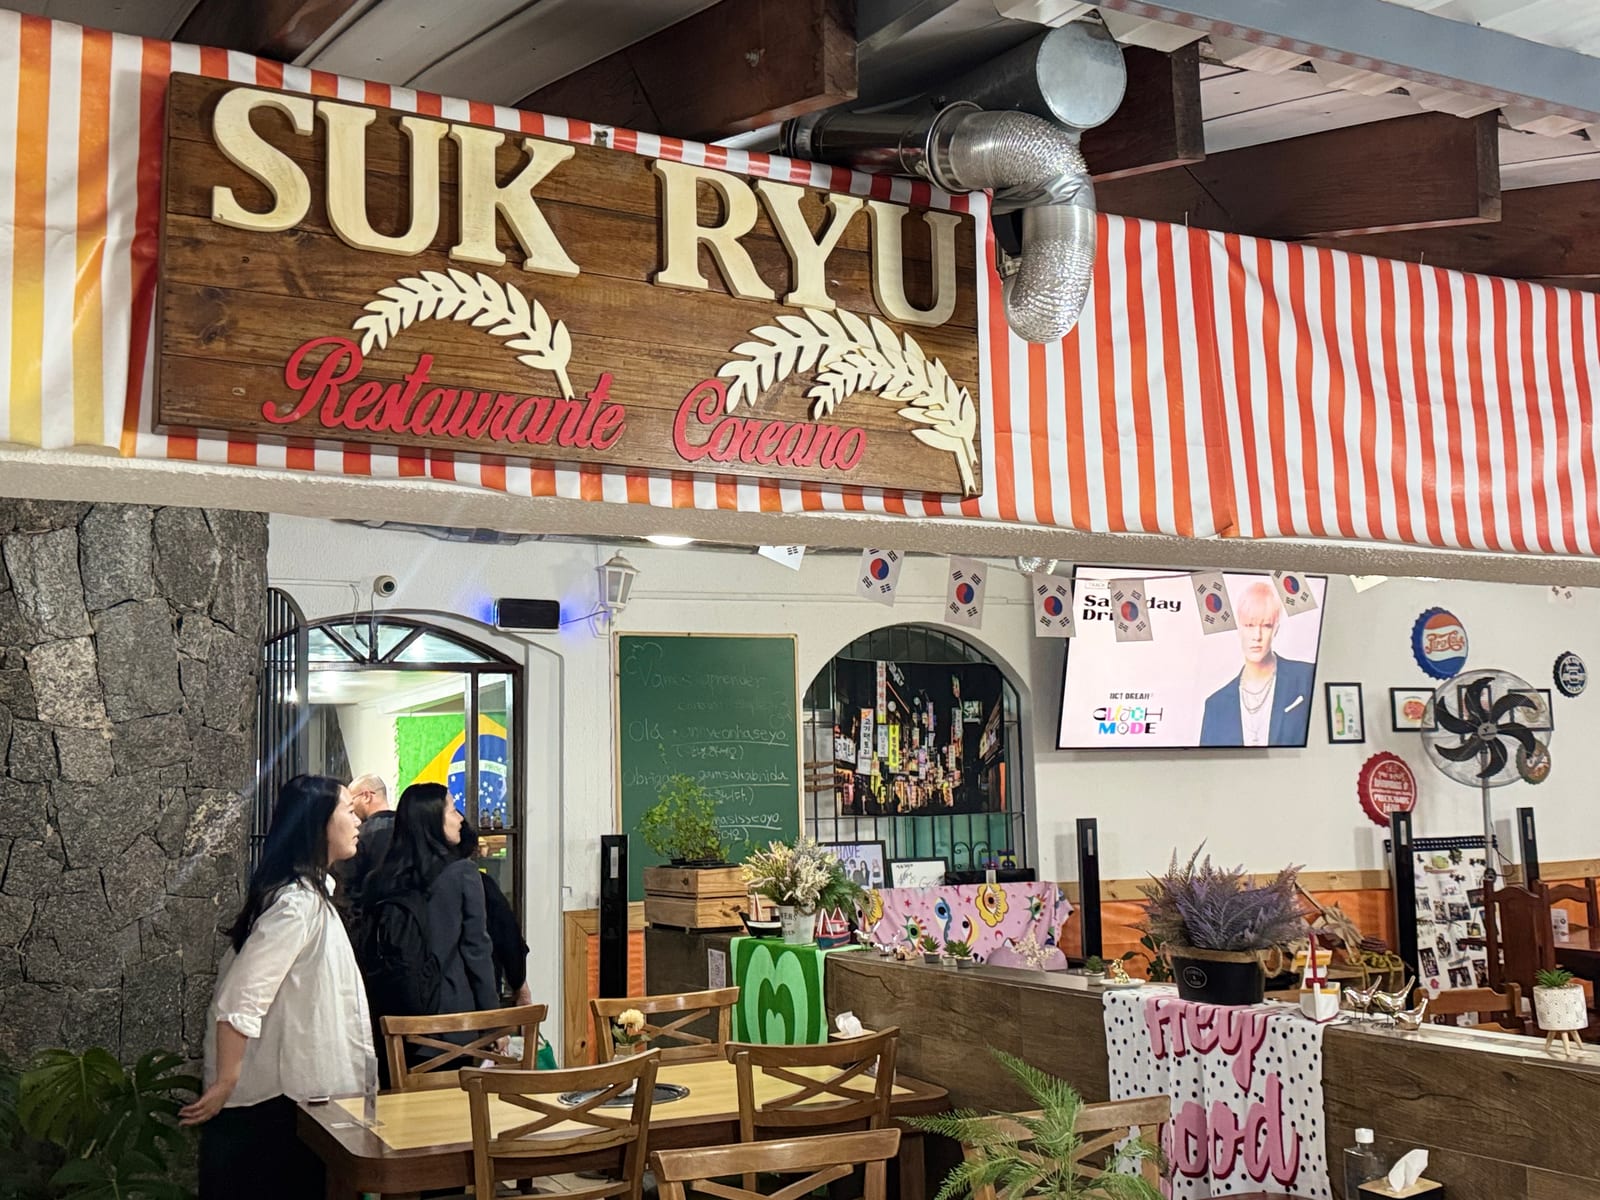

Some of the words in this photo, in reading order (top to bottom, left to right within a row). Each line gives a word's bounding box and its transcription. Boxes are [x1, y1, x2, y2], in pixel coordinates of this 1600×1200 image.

[211, 87, 580, 277] SUK
[652, 159, 962, 327] RYU
[262, 336, 626, 452] Restaurante
[673, 378, 868, 471] Coreano
[1084, 594, 1181, 613] Saday
[629, 717, 664, 742] Olá
[1098, 721, 1157, 735] MODE
